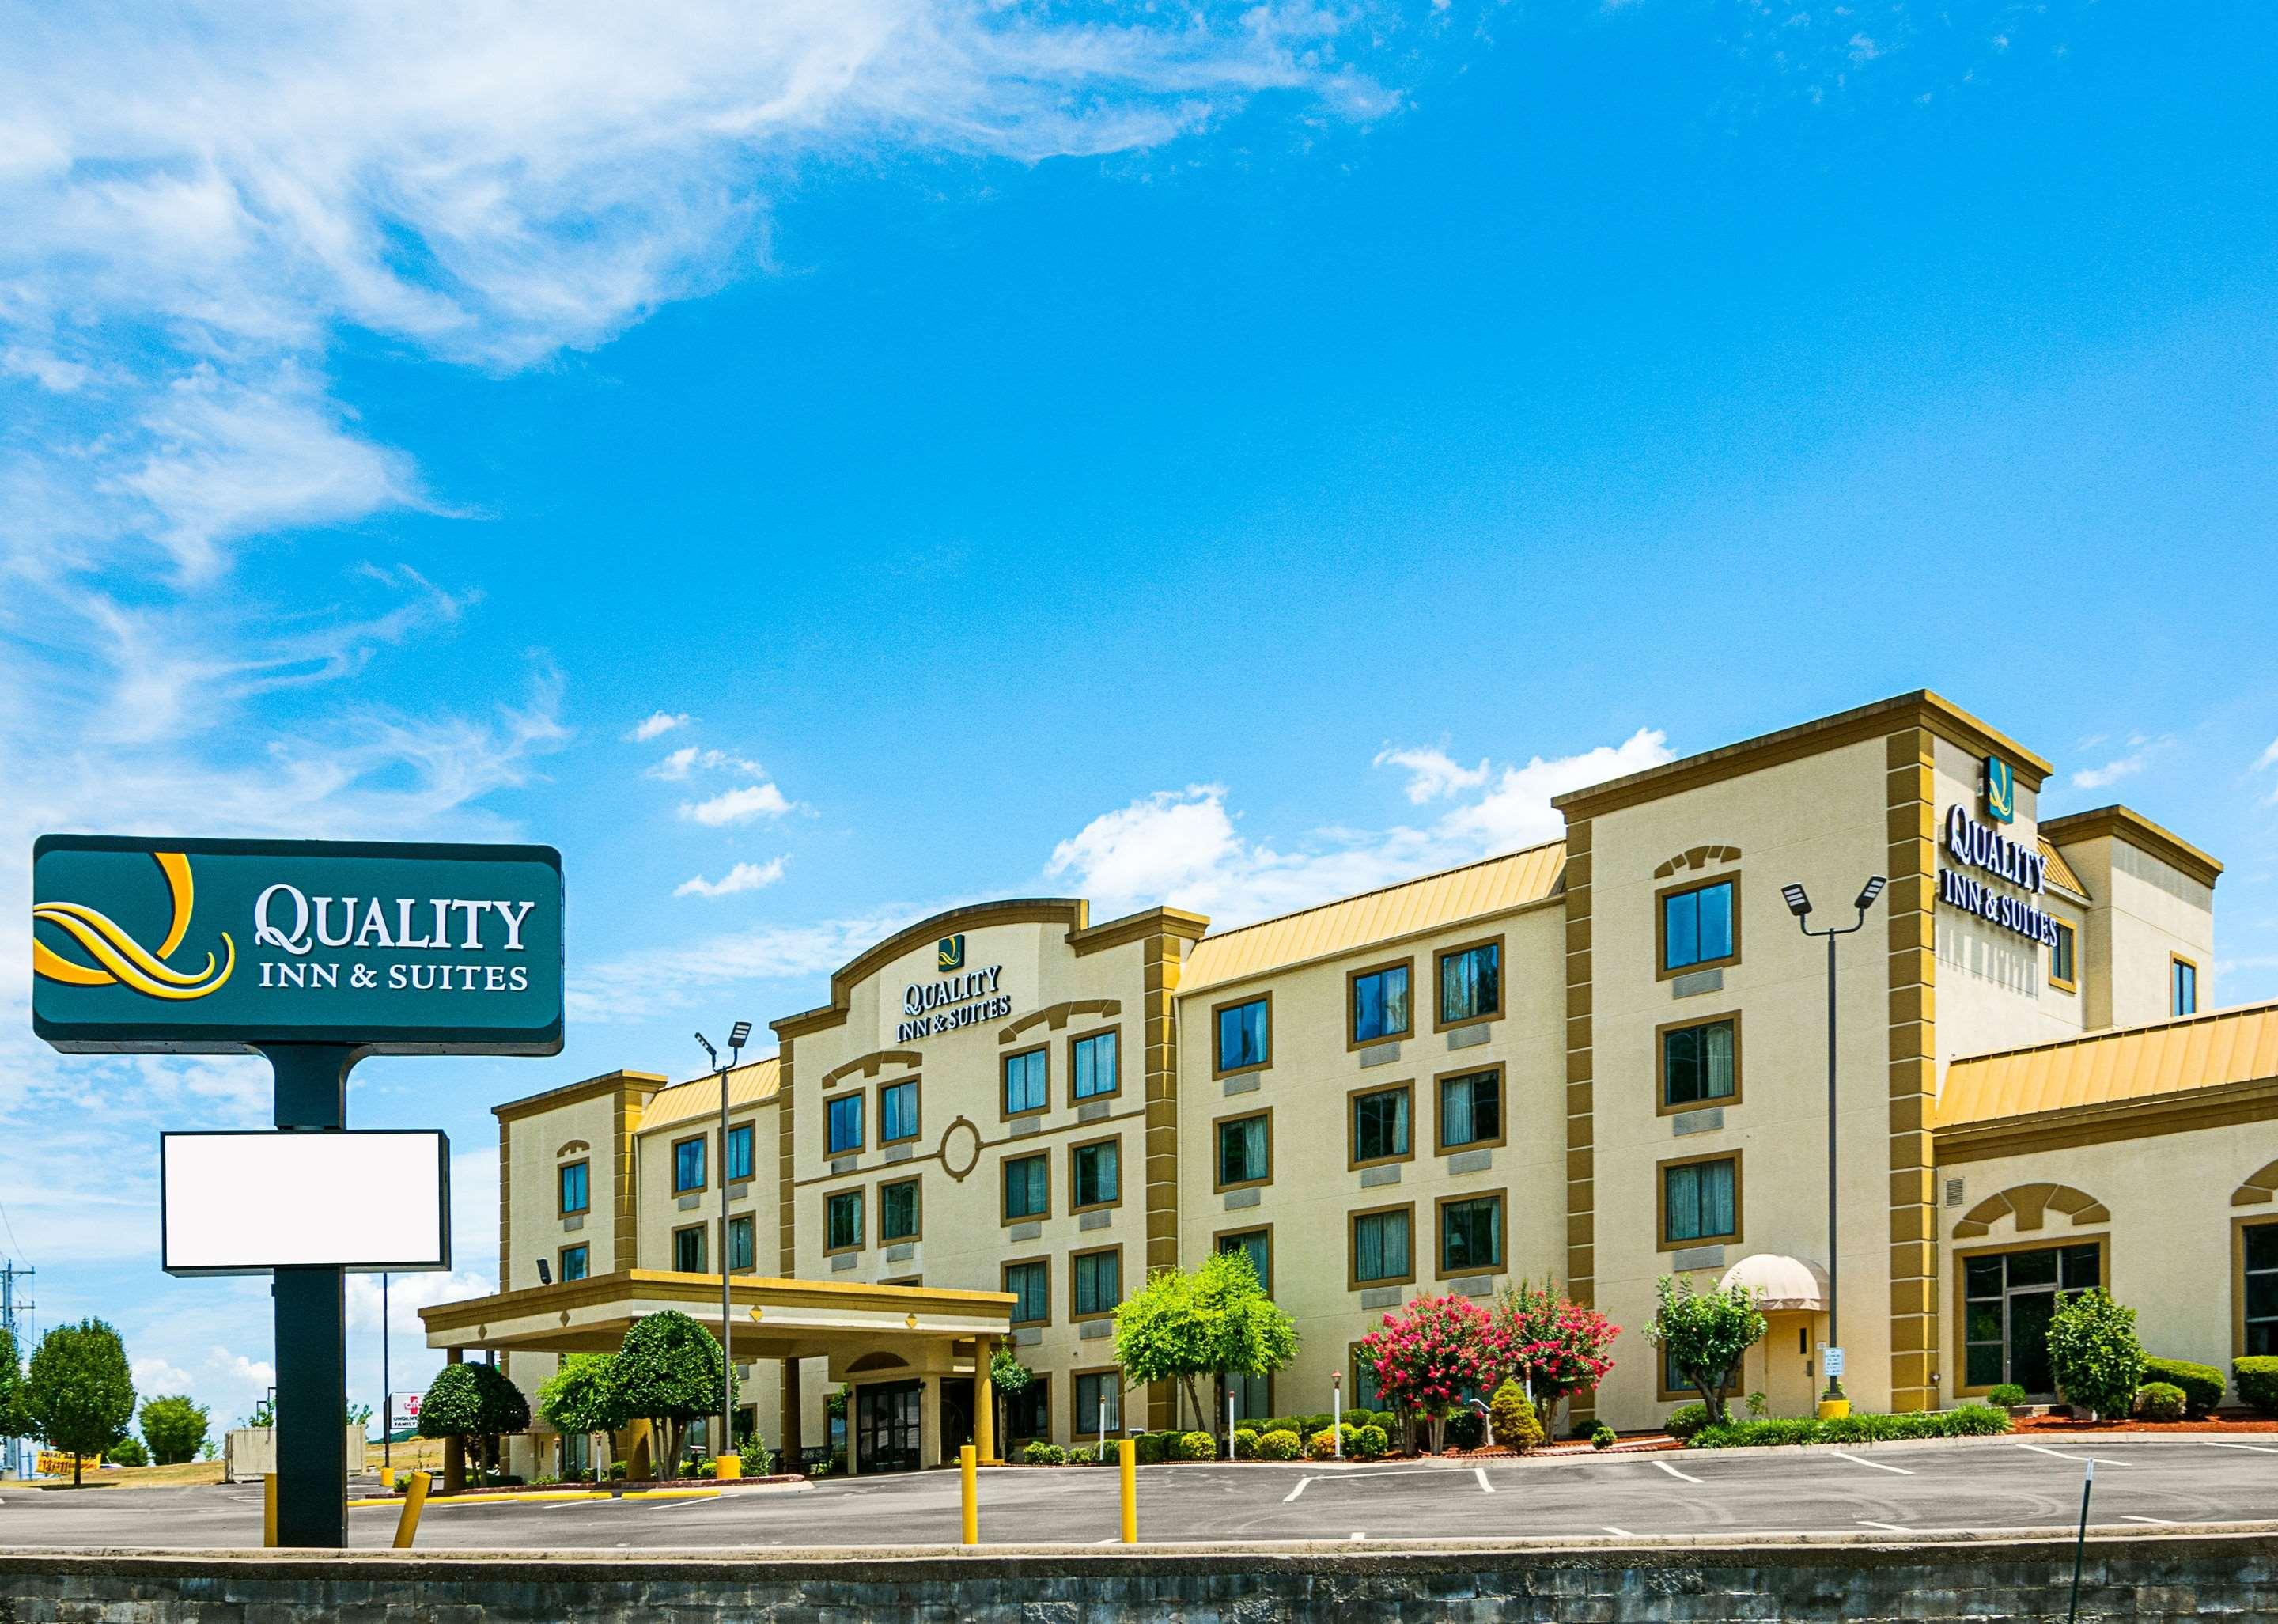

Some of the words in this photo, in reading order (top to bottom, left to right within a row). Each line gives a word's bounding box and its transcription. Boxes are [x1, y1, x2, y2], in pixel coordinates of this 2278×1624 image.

[1947, 803, 2047, 895] QUALITY
[255, 884, 535, 955] QUALITY
[1940, 869, 1981, 916] INN
[1982, 888, 1999, 922] &
[1999, 895, 2058, 948] SUITES
[259, 963, 339, 987] INN
[350, 963, 377, 988] &
[388, 964, 528, 990] SUITES
[903, 965, 1002, 1015] QUALITY
[897, 1017, 931, 1043] INN
[932, 1015, 949, 1033] &
[949, 995, 1011, 1028] SUITES
